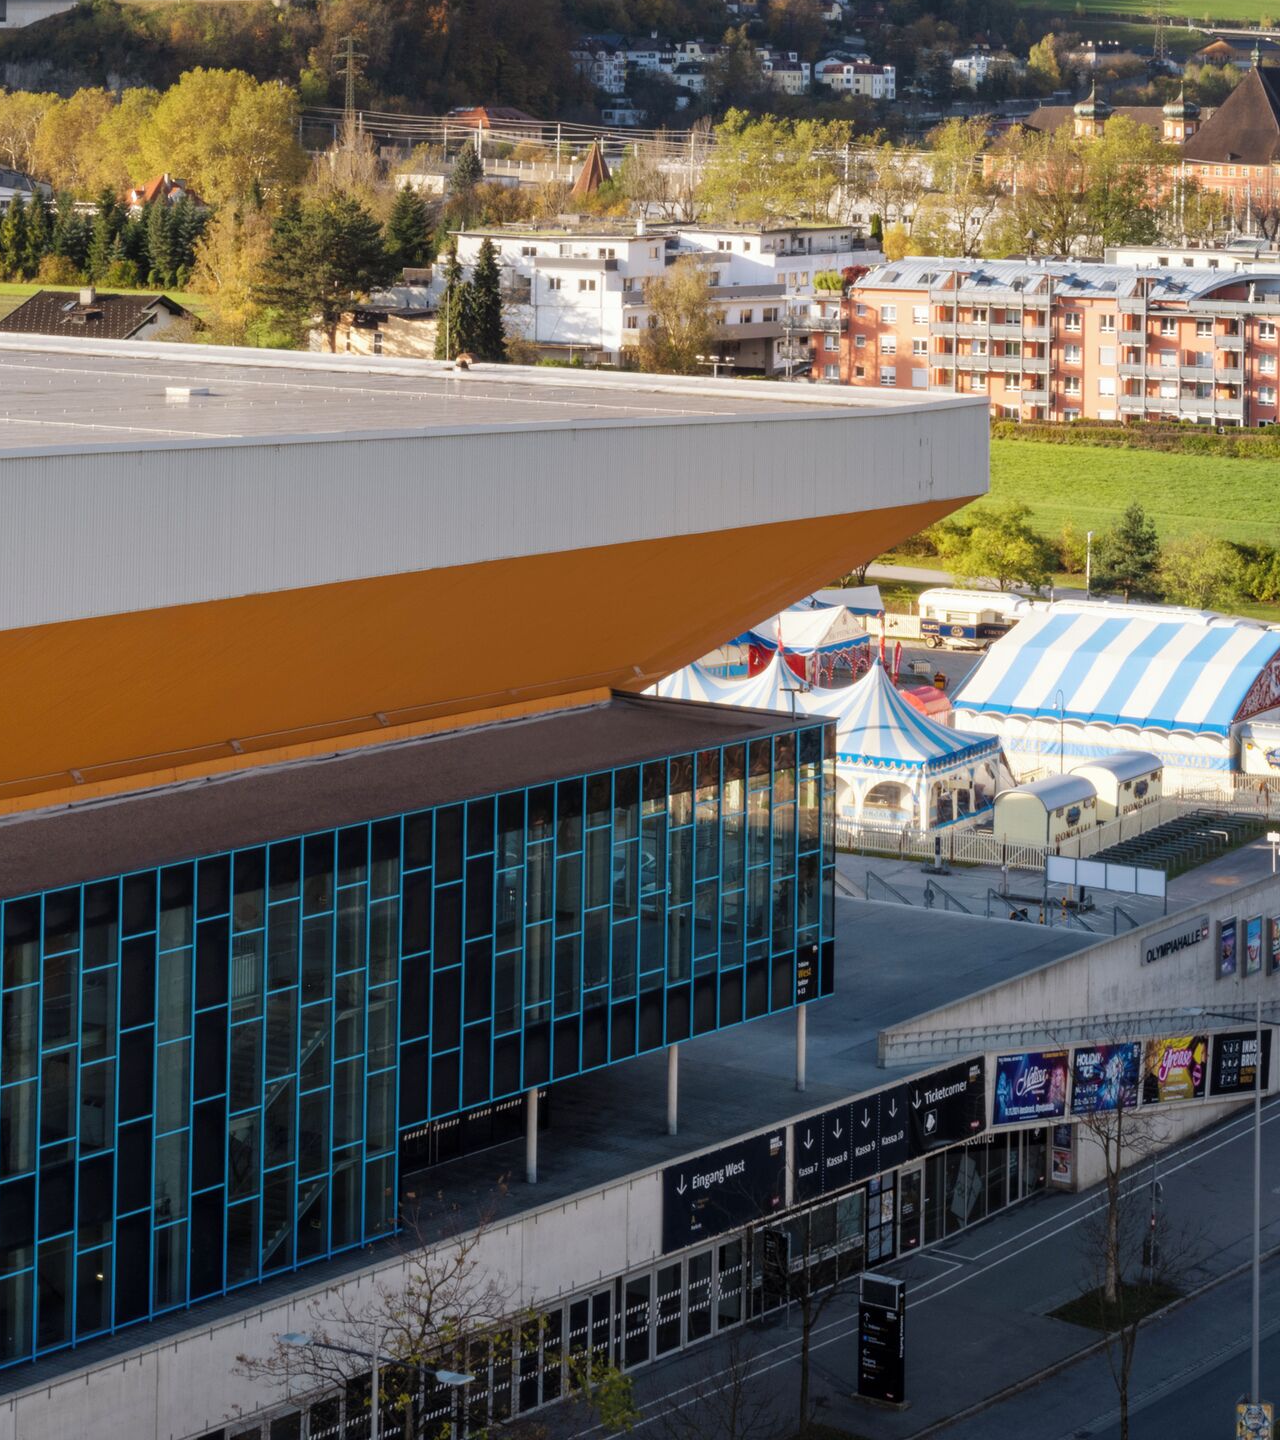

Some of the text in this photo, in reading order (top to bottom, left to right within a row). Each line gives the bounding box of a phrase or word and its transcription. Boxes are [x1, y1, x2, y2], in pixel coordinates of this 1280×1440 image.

[1123, 794, 1162, 815] RONCALLI
[1055, 823, 1091, 843] RONCALLI
[1146, 929, 1201, 964] OLYMPIAHALLE
[924, 1080, 968, 1105] Ticketcorner
[882, 1130, 905, 1146] Kassa 10
[855, 1140, 876, 1157] Kassa 9
[826, 1151, 849, 1168] Kassa 8
[692, 1160, 745, 1189] Eingang West
[798, 1162, 819, 1178] Kassa 7
